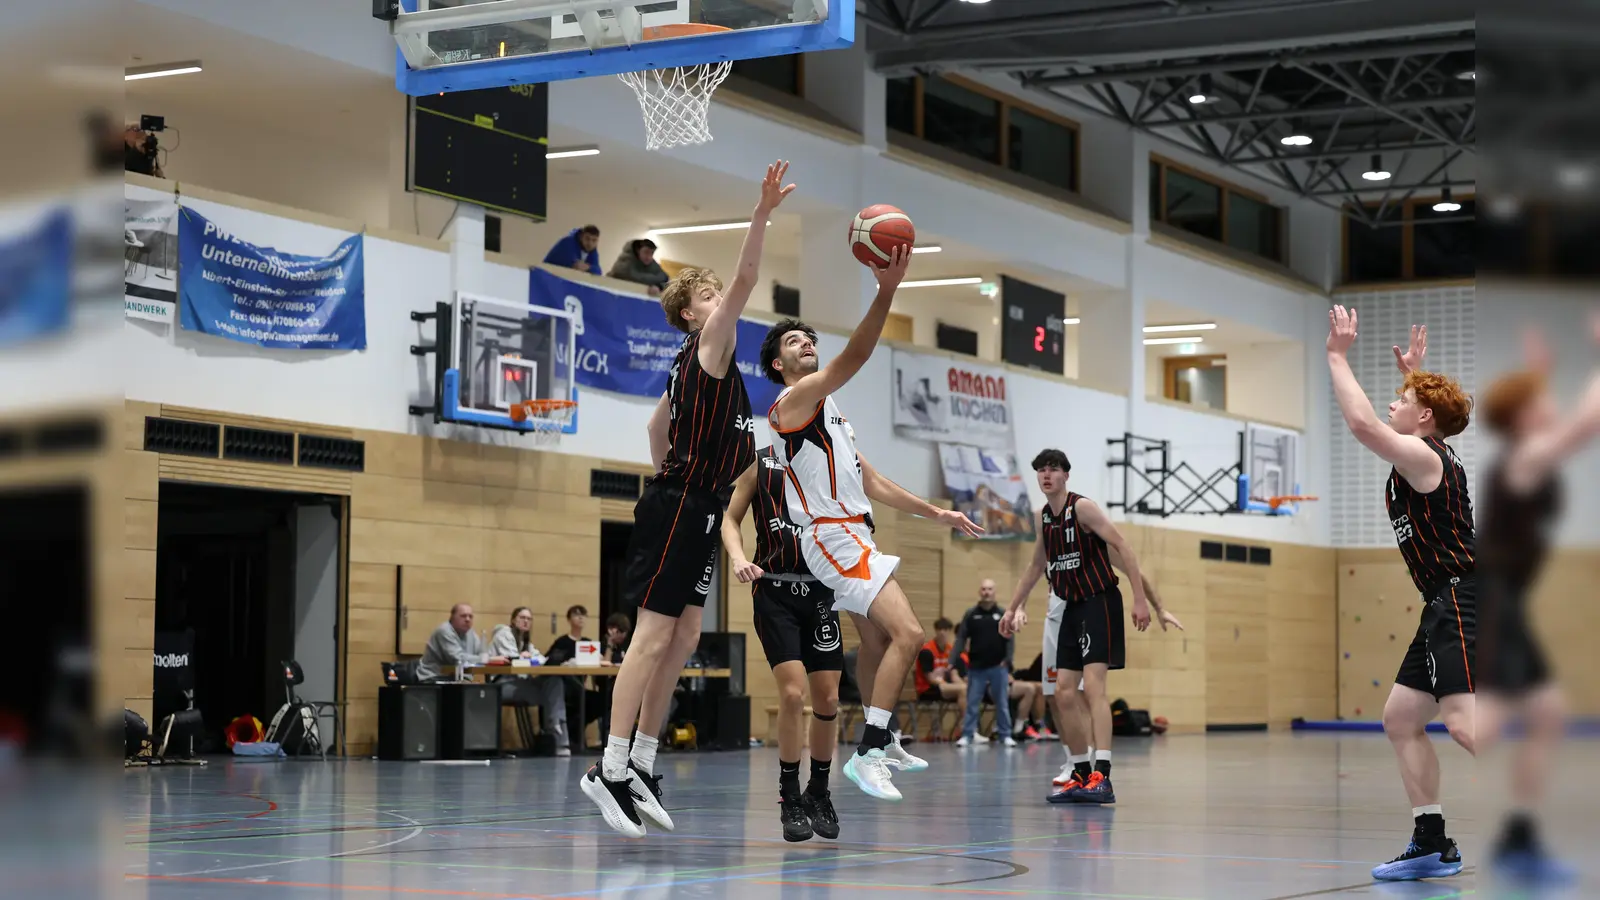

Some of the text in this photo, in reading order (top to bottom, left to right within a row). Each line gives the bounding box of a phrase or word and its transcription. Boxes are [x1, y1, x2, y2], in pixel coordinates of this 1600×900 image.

[125, 302, 167, 316] ANDWERK
[230, 309, 247, 321] Fax:
[1034, 325, 1045, 352] 2
[1065, 527, 1075, 543] 11
